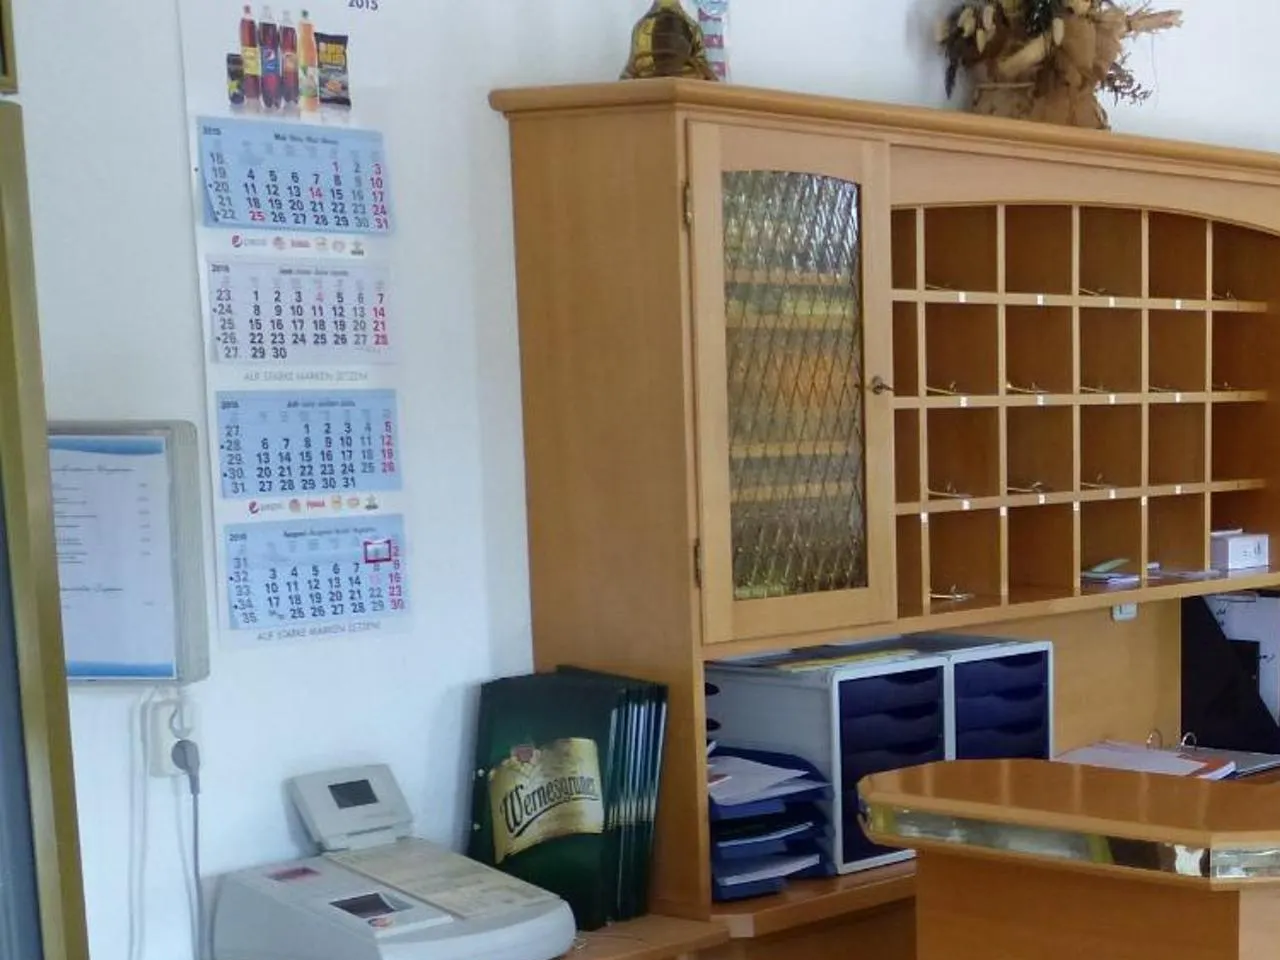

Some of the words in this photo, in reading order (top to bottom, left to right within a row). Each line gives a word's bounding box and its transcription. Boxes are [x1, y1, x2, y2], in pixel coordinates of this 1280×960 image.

[332, 161, 339, 172] 1
[354, 162, 361, 173] 2
[374, 164, 381, 175] 3
[247, 168, 255, 181] 4
[269, 171, 278, 182] 5
[291, 172, 299, 182] 6
[314, 174, 320, 185] 7
[335, 175, 342, 186] 8
[355, 175, 362, 186] 9
[370, 177, 383, 188] 10
[244, 183, 257, 195] 11
[266, 185, 280, 196] 12
[287, 186, 301, 198] 13
[309, 187, 323, 198] 14
[330, 189, 344, 200] 15
[352, 190, 364, 201] 16
[372, 191, 384, 203] 17
[247, 197, 261, 209] 18
[268, 199, 283, 210] 19
[289, 200, 304, 211] 20
[310, 201, 324, 212] 21
[332, 202, 345, 214] 22
[352, 203, 366, 215] 23
[373, 204, 387, 216] 24
[250, 211, 265, 221] 25
[272, 211, 287, 223] 26
[293, 213, 307, 224] 27
[314, 214, 328, 226] 28
[335, 215, 349, 226] 29
[355, 216, 369, 228] 30
[375, 217, 389, 229] 31
[254, 291, 259, 301] 1
[274, 291, 281, 302] 2
[295, 292, 302, 302] 3
[316, 292, 324, 303] 4
[336, 292, 344, 303] 5
[357, 293, 364, 303] 6
[378, 293, 384, 305] 7
[254, 305, 261, 316] 8
[275, 305, 282, 316] 9
[291, 306, 303, 317] 10
[312, 306, 324, 317] 11
[332, 306, 345, 317] 12
[353, 307, 365, 318] 13
[373, 307, 385, 318] 14
[250, 319, 262, 330] 15
[271, 319, 284, 331] 16
[292, 320, 305, 331] 17
[313, 320, 326, 331] 18
[334, 320, 346, 331] 19
[353, 321, 366, 331] 20
[373, 321, 386, 332] 21
[250, 333, 264, 344] 22
[271, 333, 285, 344] 23
[292, 334, 306, 345] 24
[313, 334, 327, 345] 25
[334, 334, 347, 345] 26
[354, 335, 368, 345] 27
[375, 335, 389, 346] 28
[251, 347, 265, 359] 29
[272, 348, 288, 359] 30
[304, 424, 310, 434] 1
[325, 424, 332, 434] 2
[345, 423, 352, 434] 3
[364, 423, 372, 433] 4
[385, 422, 392, 432] 5
[261, 439, 269, 450] 6
[283, 439, 290, 449] 7
[304, 438, 311, 449] 8
[325, 437, 332, 448] 9
[341, 437, 352, 447] 10
[360, 436, 372, 446] 11
[381, 436, 394, 446] 12
[257, 453, 270, 465] 13
[279, 452, 292, 464] 14
[300, 452, 313, 463] 15
[320, 451, 333, 462] 16
[341, 451, 353, 461] 17
[362, 450, 374, 460] 18
[382, 449, 394, 460] 19
[257, 467, 272, 479] 20
[278, 466, 293, 478] 21
[300, 465, 314, 477] 22
[320, 464, 335, 476] 23
[341, 463, 355, 475] 24
[361, 463, 375, 474] 25
[382, 462, 395, 473] 26
[259, 481, 273, 492] 27
[280, 480, 295, 491] 28
[302, 479, 316, 490] 29
[322, 478, 336, 489] 30
[343, 478, 356, 488] 31
[392, 546, 399, 557] 2
[269, 569, 277, 580] 3
[291, 567, 298, 578] 4
[312, 565, 319, 576] 5
[333, 563, 340, 574] 6
[354, 562, 360, 573] 7
[393, 560, 400, 570] 9
[266, 583, 279, 594] 10
[287, 581, 300, 592] 11
[308, 579, 320, 590] 12
[328, 578, 341, 588] 13
[349, 576, 361, 587] 14
[389, 573, 401, 584] 16
[268, 596, 280, 608] 17
[288, 595, 301, 606] 18
[309, 593, 323, 605] 19
[329, 592, 343, 602] 20
[349, 590, 363, 600] 21
[369, 588, 383, 599] 22
[389, 586, 402, 597] 23
[290, 608, 305, 620] 25
[311, 606, 325, 617] 26
[332, 604, 345, 616] 27
[352, 602, 365, 614] 28
[372, 601, 385, 611] 29
[390, 598, 405, 610] 30
